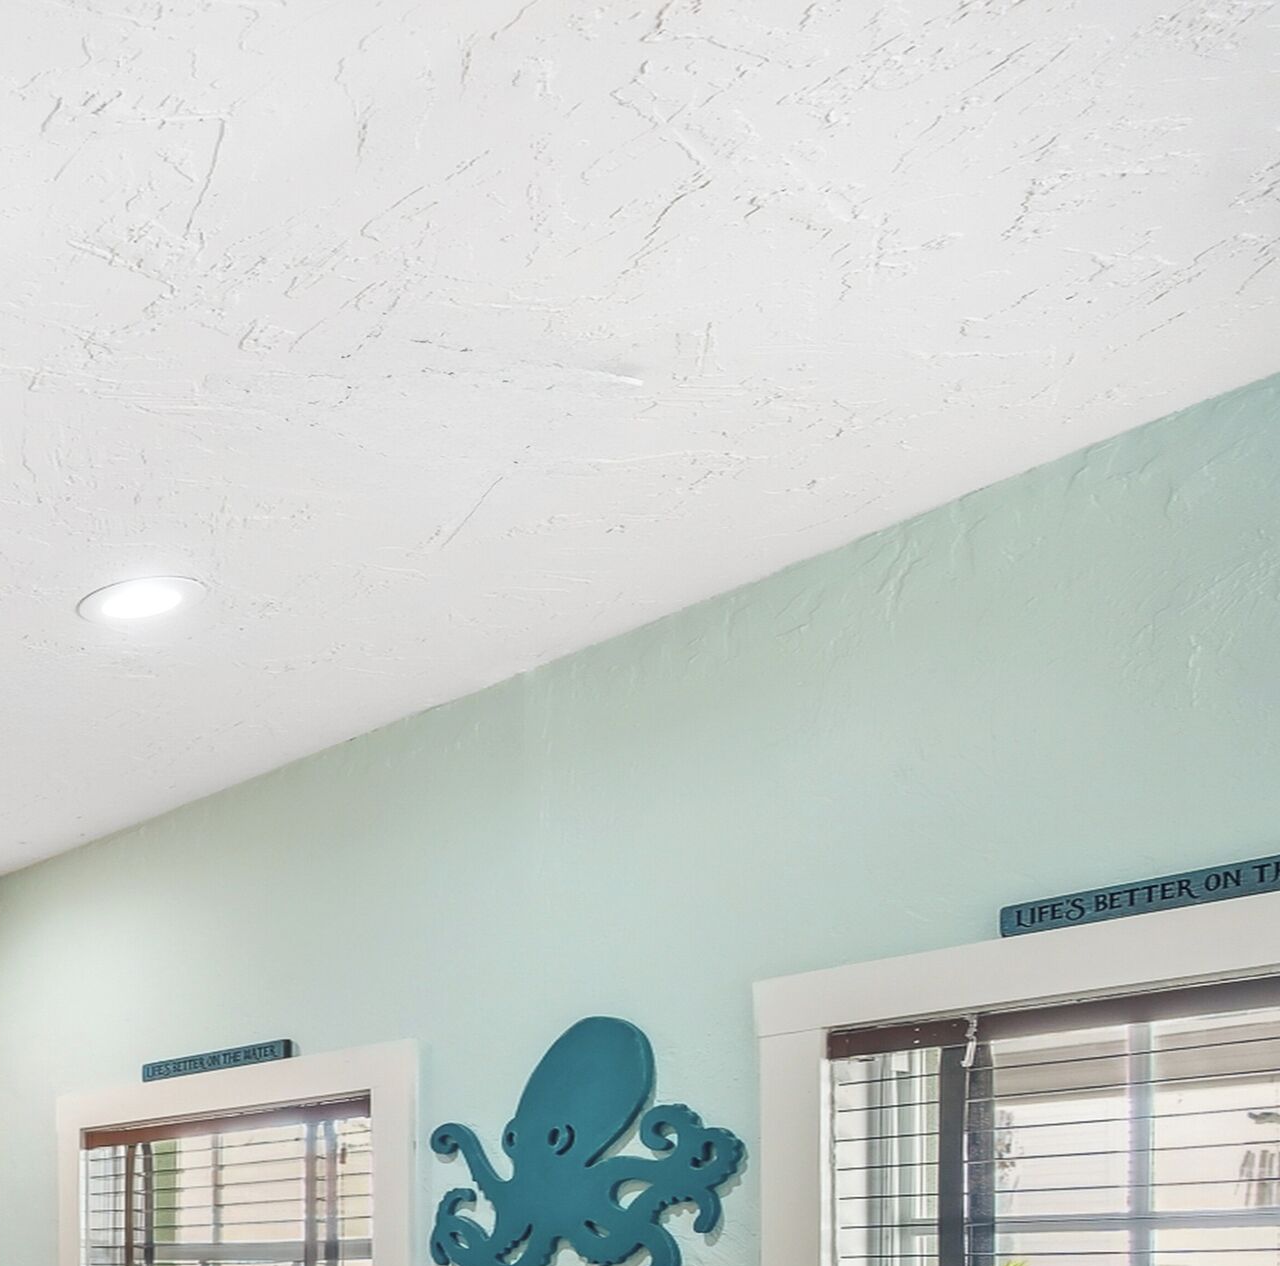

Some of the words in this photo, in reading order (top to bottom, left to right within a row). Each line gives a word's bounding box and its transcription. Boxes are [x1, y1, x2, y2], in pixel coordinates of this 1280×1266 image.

[1015, 897, 1086, 928] LIFE'S
[1094, 878, 1200, 913] BETTER
[1203, 868, 1243, 892] ON
[172, 1057, 206, 1073] BETTER
[206, 1055, 222, 1067] ON
[223, 1051, 241, 1065] THE
[243, 1044, 279, 1061] WATER
